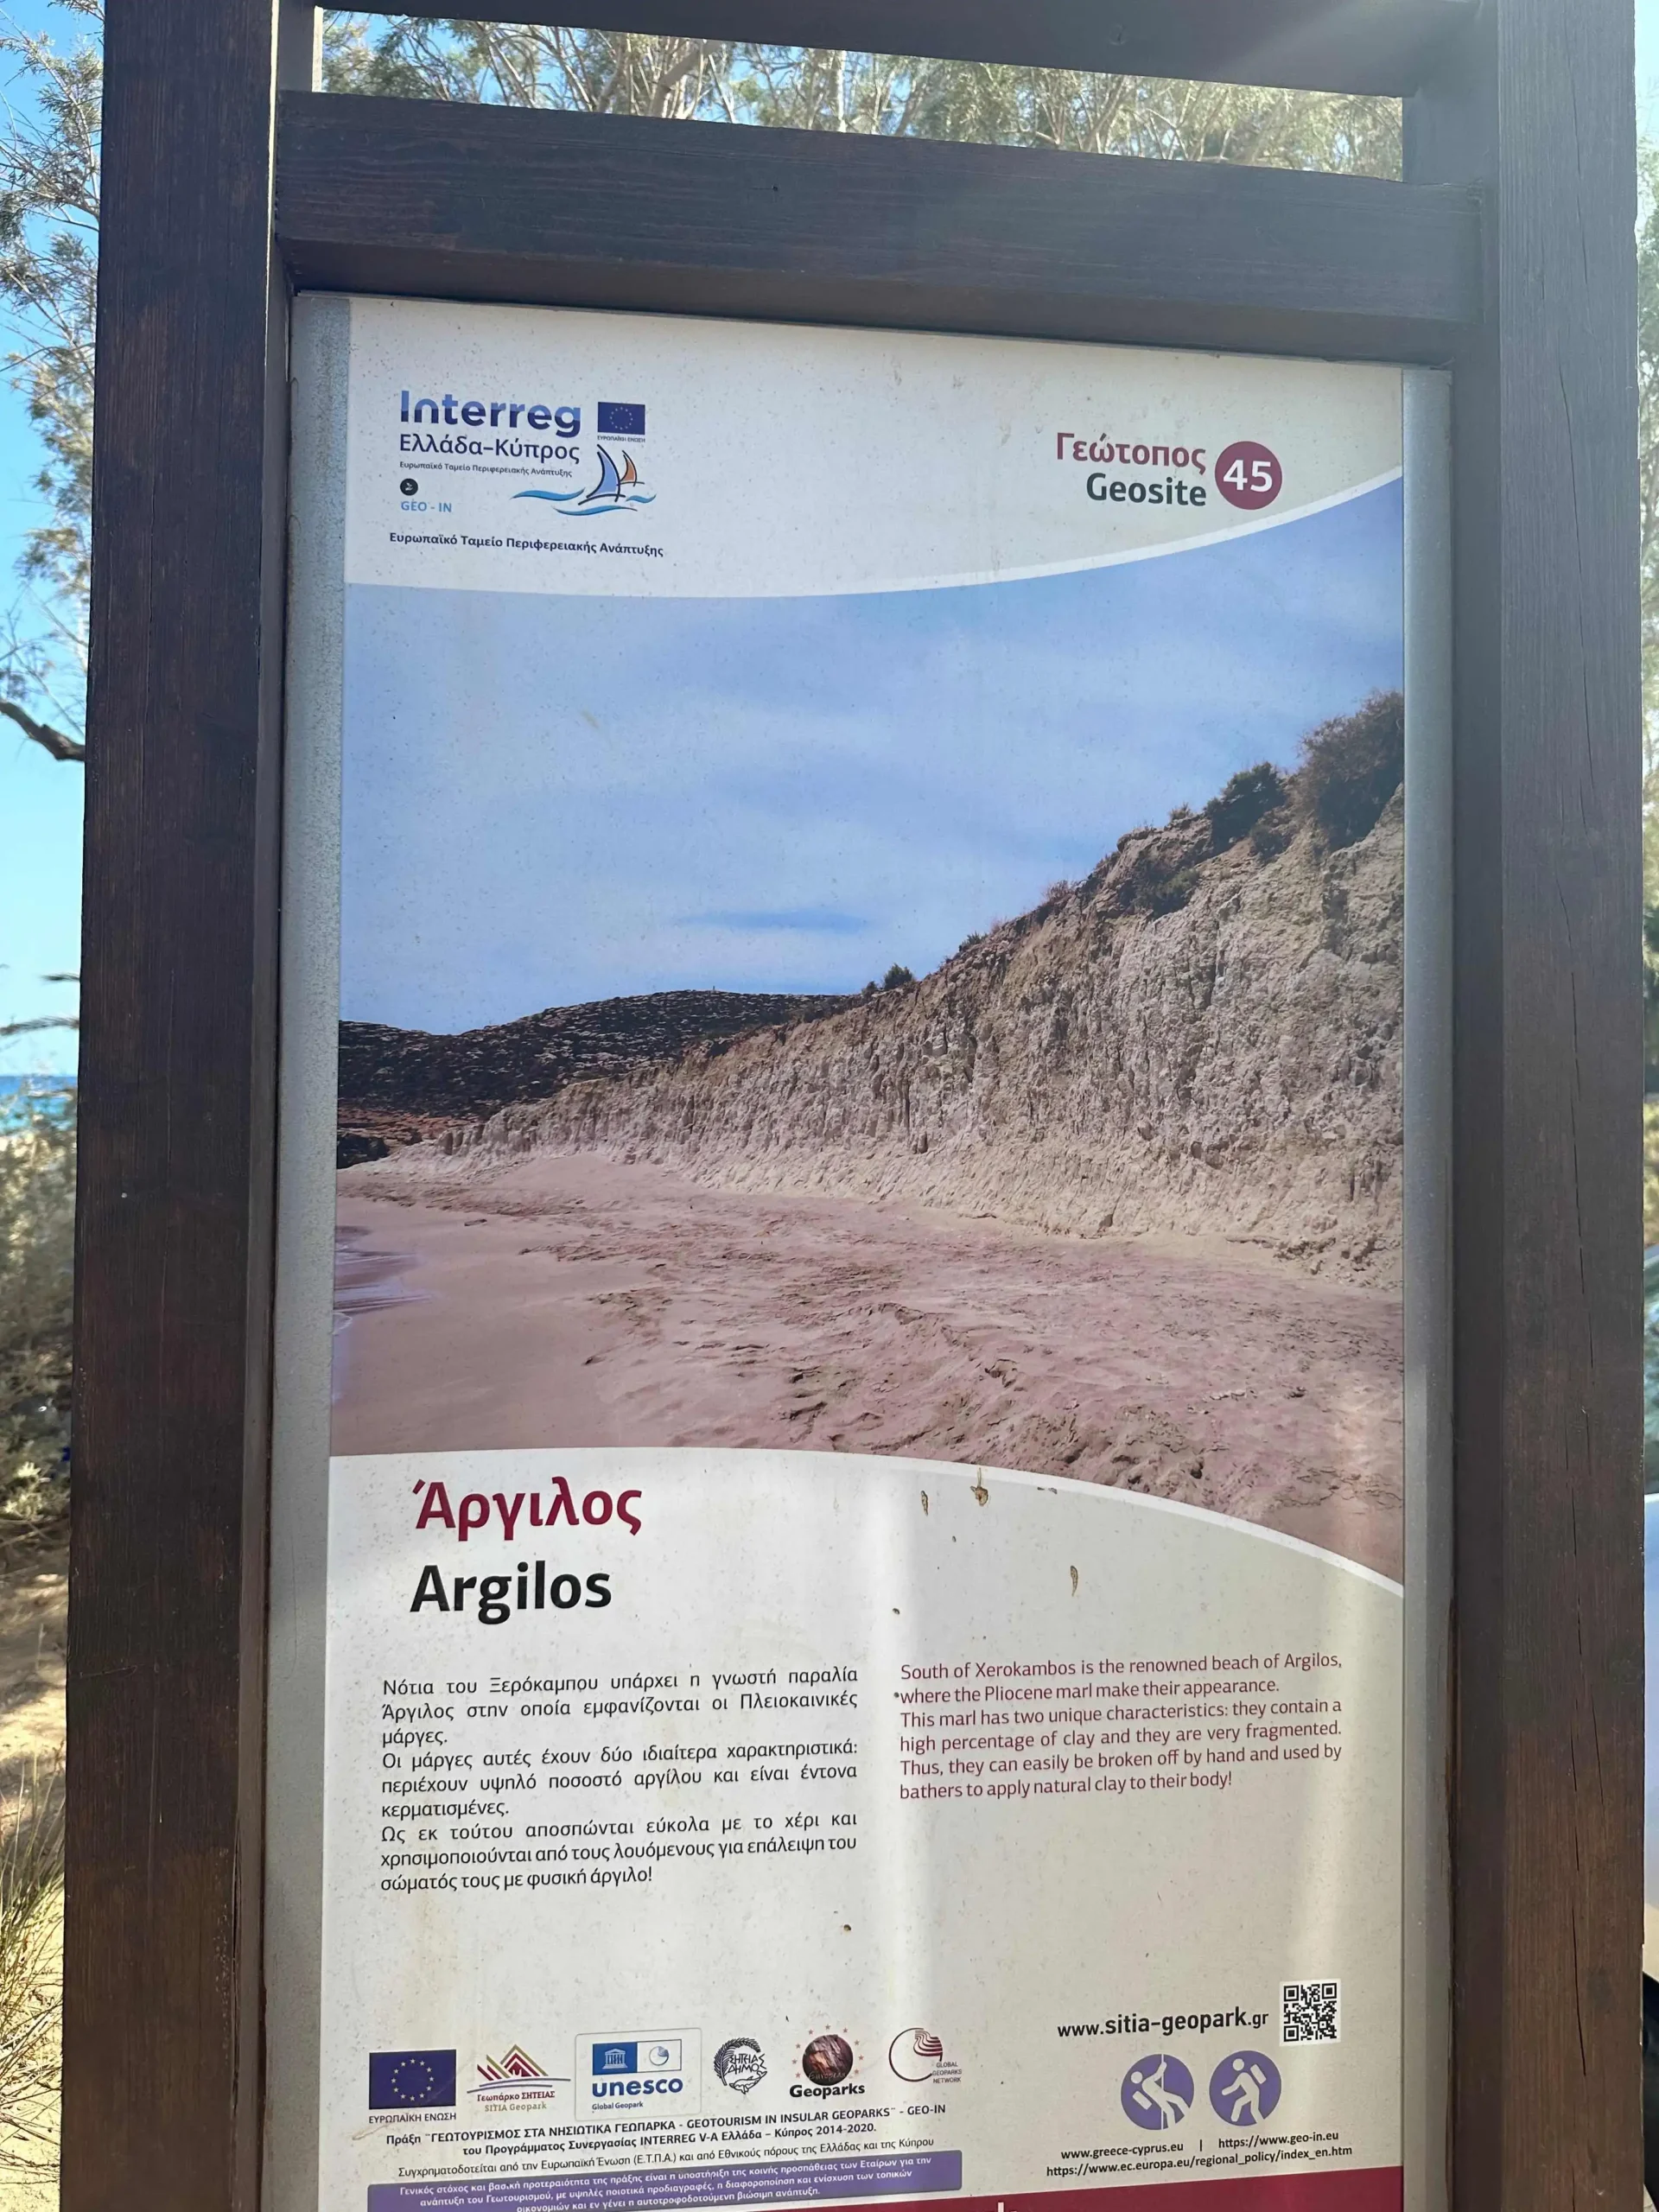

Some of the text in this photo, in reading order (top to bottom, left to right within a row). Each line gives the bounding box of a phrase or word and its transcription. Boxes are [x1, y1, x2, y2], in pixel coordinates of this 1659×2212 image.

[400, 390, 582, 438] Interreg
[1057, 432, 1206, 475] Γεώτοπος
[1086, 472, 1206, 506] Geosite
[1223, 459, 1273, 493] 45
[401, 500, 428, 512] GEO
[438, 502, 452, 512] IN
[390, 532, 664, 558] Ευρωπαϊκό Ταμείο Περιφερειακής Ανάπτυξης
[412, 1476, 642, 1541] Άργιλος
[410, 1560, 612, 1624] Argilos
[384, 1679, 435, 1695] Νότια
[446, 1681, 477, 1694] του
[489, 1676, 598, 1697] Ξερόκαμπου
[611, 1672, 678, 1693] υπάρχει
[712, 1668, 776, 1690] γνωστή
[789, 1666, 858, 1688] παραλία
[901, 1652, 1342, 1680] South of Xerokambos is the renowned beach of Argilos,
[381, 1690, 858, 1724] Άργιλος στην οποία εμφανίζονται οι Πλειοκαινικές
[900, 1681, 1280, 1704] where the Pliocene marl make their appearance.
[899, 1700, 1342, 1728] This marl has two unique characteristics: they contain a
[383, 1727, 448, 1749] μάργες.
[900, 1719, 1341, 1756] high percentage of clay and they are very fragmented.
[383, 1738, 857, 1772] Οι μάργες αυτές έχουν δύο ιδιαίτερα χαρακτηριστικά:
[899, 1743, 1342, 1777] Thus, they can easily be broken off by hand and used by
[382, 1764, 857, 1797] περιέχουν υψηλό ποσοστό αργίλου και είναι έντονα
[899, 1770, 1231, 1800] bathers to apply natural clay to their body!
[382, 1799, 509, 1821] κερματισμένες.
[381, 1811, 857, 1845] Ως εκ τούτου αποσπώνται εύκολα με το χέρι και
[380, 1836, 856, 1871] χρησιμοποιούνται από τους λουόμενους για επάλειψη του
[380, 1866, 652, 1895] σώματός τους με φυσική άργιλο!
[1057, 2005, 1269, 2037] www.sitia-geopark.gr
[477, 2090, 556, 2103] Γεωπάρκο ΣΗΤΕΙΑΣ
[592, 2078, 683, 2097] unesco
[788, 2083, 866, 2100] Geoparks
[424, 2111, 457, 2122] ΕΝΩΣΗ
[485, 2101, 547, 2113] SITIA Geopark
[614, 2101, 644, 2111] Geopark
[386, 2133, 421, 2147] Πράξη
[524, 2127, 546, 2139] ΣΤΑ
[549, 2124, 612, 2137] ΝΗΣΙΩΤΙΚΑ
[614, 2120, 676, 2133] ΓΕΩΠΑΡΚΑ
[686, 2115, 761, 2129] GEOTOURISM
[765, 2114, 777, 2125] IN
[780, 2111, 829, 2124] INSULAR
[906, 2104, 945, 2115] GEO-IN
[1060, 2132, 1339, 2160] www.greece-cyprus.eu https://www.geo-in.eu
[1046, 2146, 1352, 2178] https://www.ec.europa.eu/regional_policy/index_en.htm
